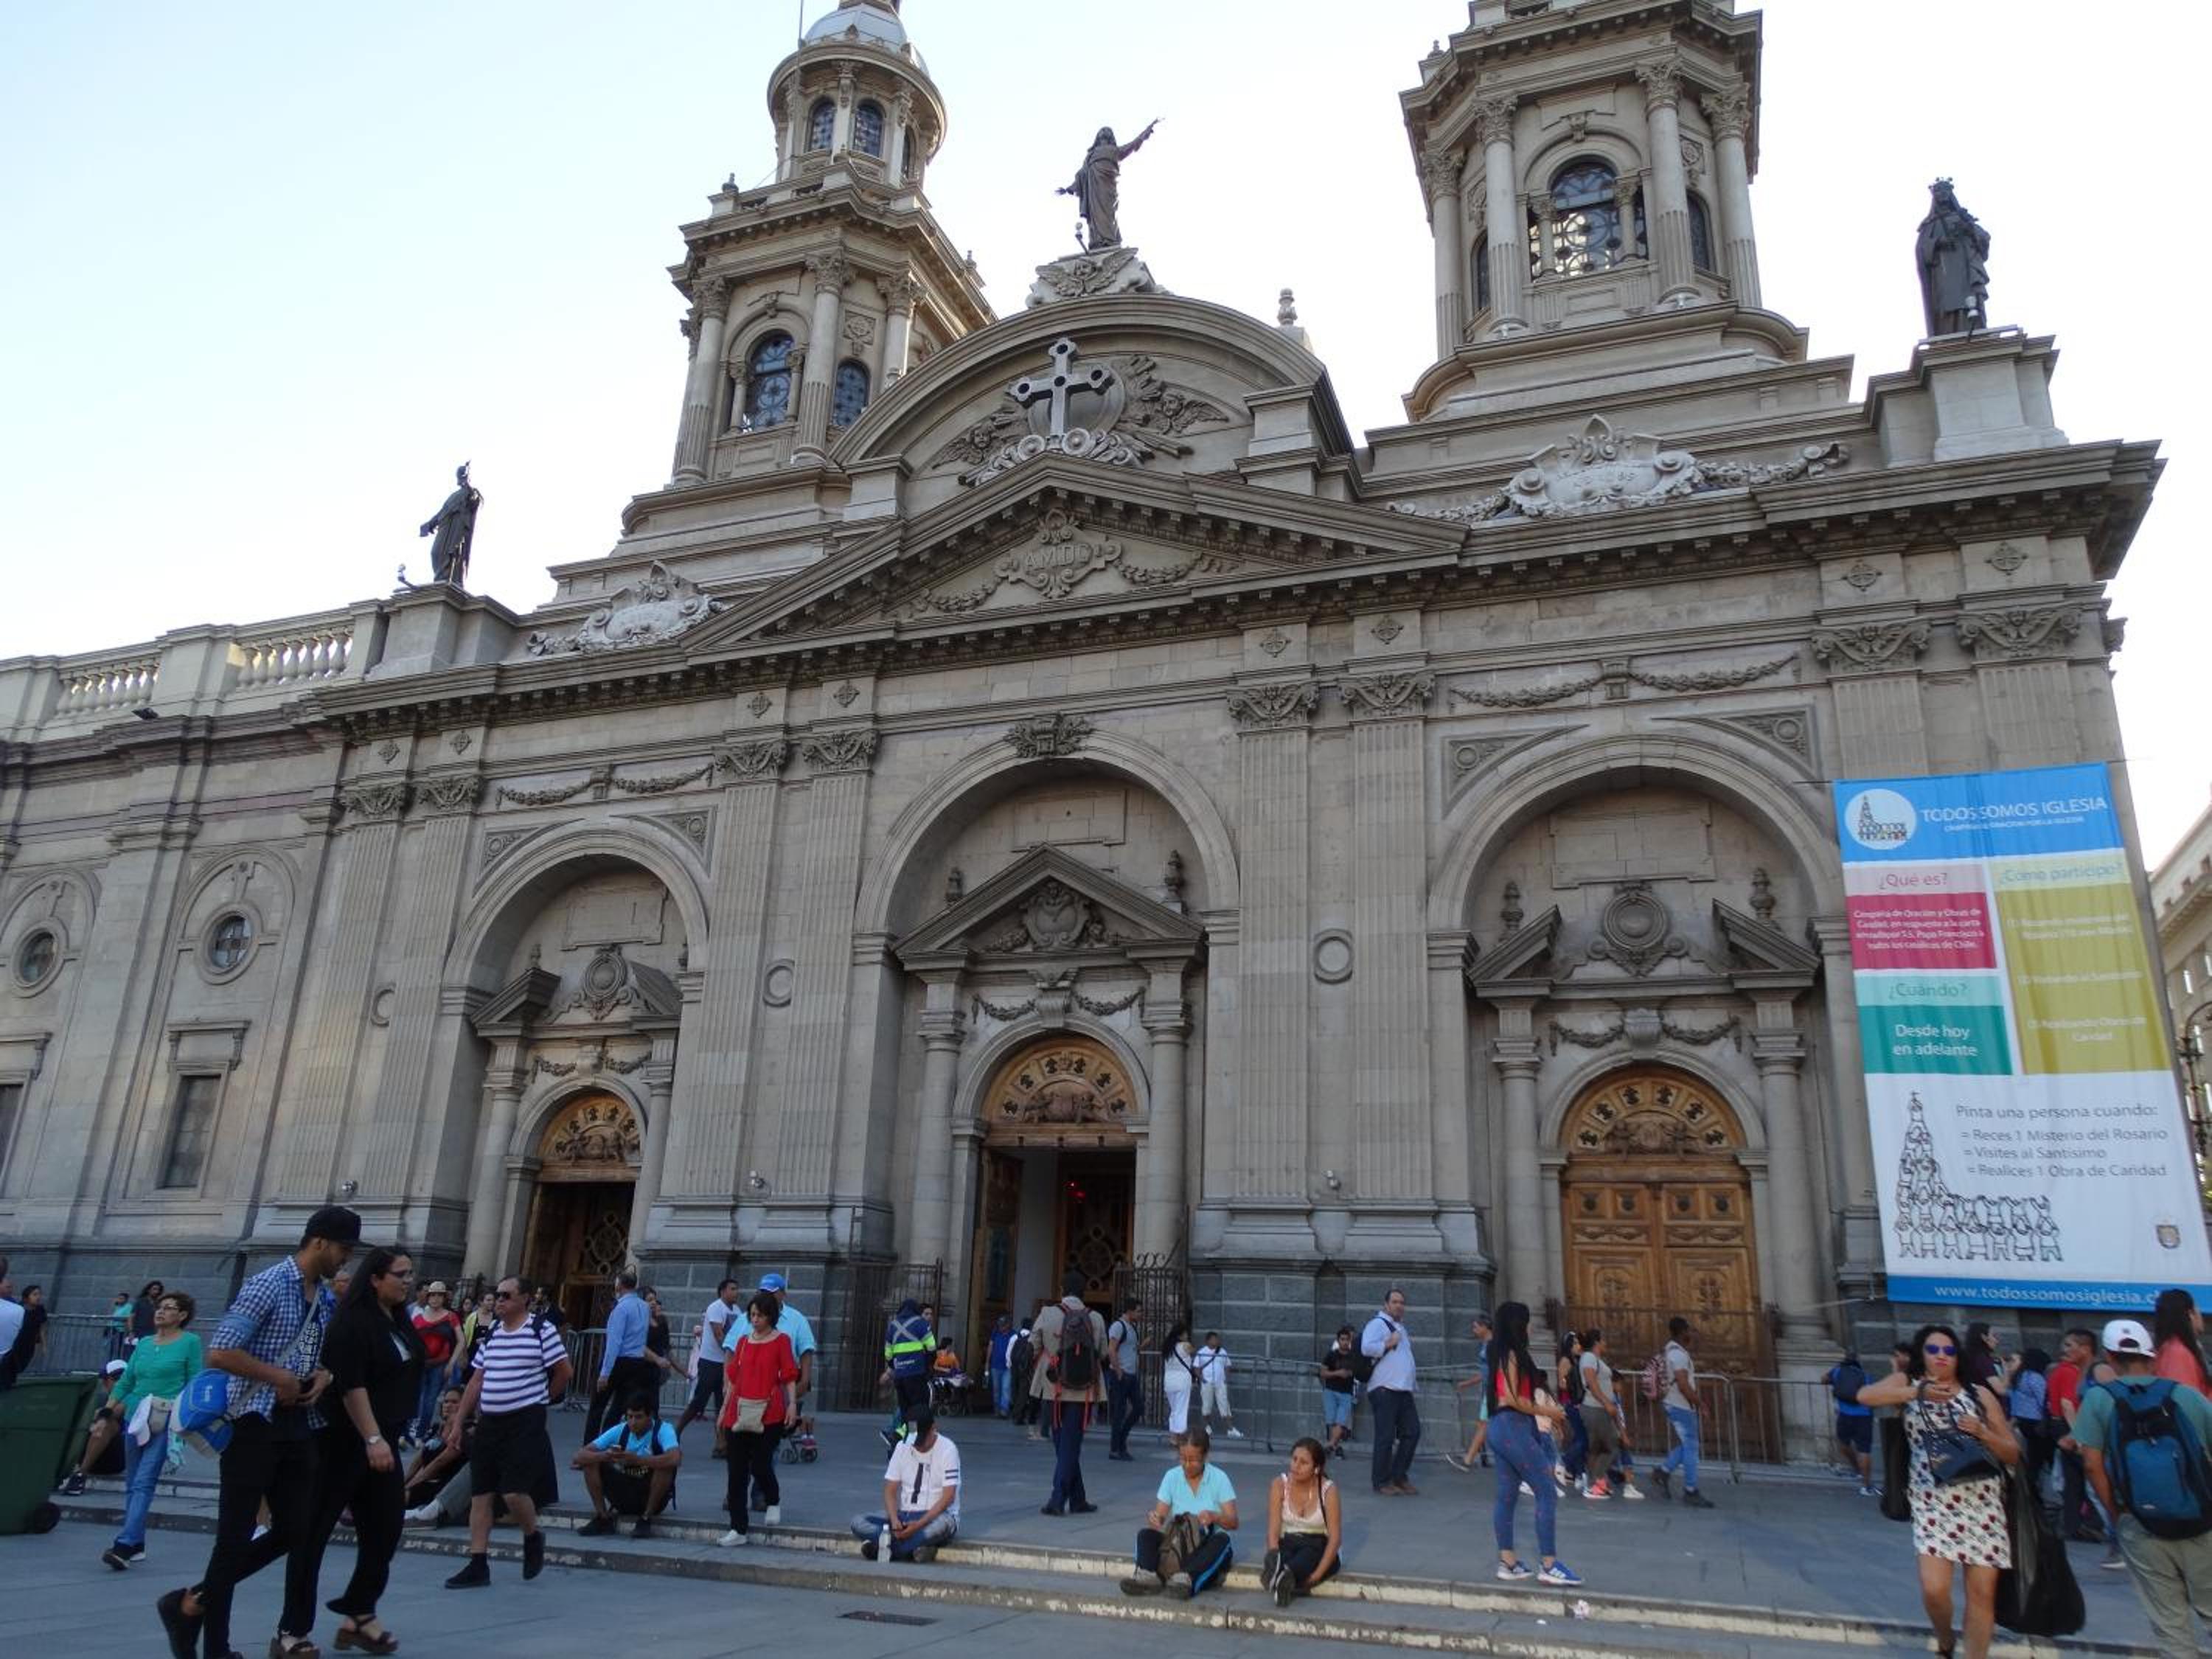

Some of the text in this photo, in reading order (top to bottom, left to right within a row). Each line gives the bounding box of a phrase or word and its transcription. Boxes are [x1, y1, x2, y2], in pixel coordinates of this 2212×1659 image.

[1923, 797, 2107, 823] TODOS SOMOS IGLESIA
[1923, 872, 1948, 886] es?
[1895, 1023, 1971, 1040] Desde hoy
[1893, 1043, 1979, 1057] en adelante
[1956, 1105, 1993, 1118] Pinta
[1997, 1108, 2024, 1119] una
[2028, 1107, 2090, 1121] persona
[2027, 1130, 2083, 1141] Misterio
[2087, 1128, 2109, 1141] del
[2112, 1128, 2168, 1141] Rosario
[1975, 1147, 2018, 1158] Visites
[2048, 1164, 2084, 1178] Obra
[2087, 1164, 2106, 1177] de
[2109, 1163, 2167, 1176] Caridad
